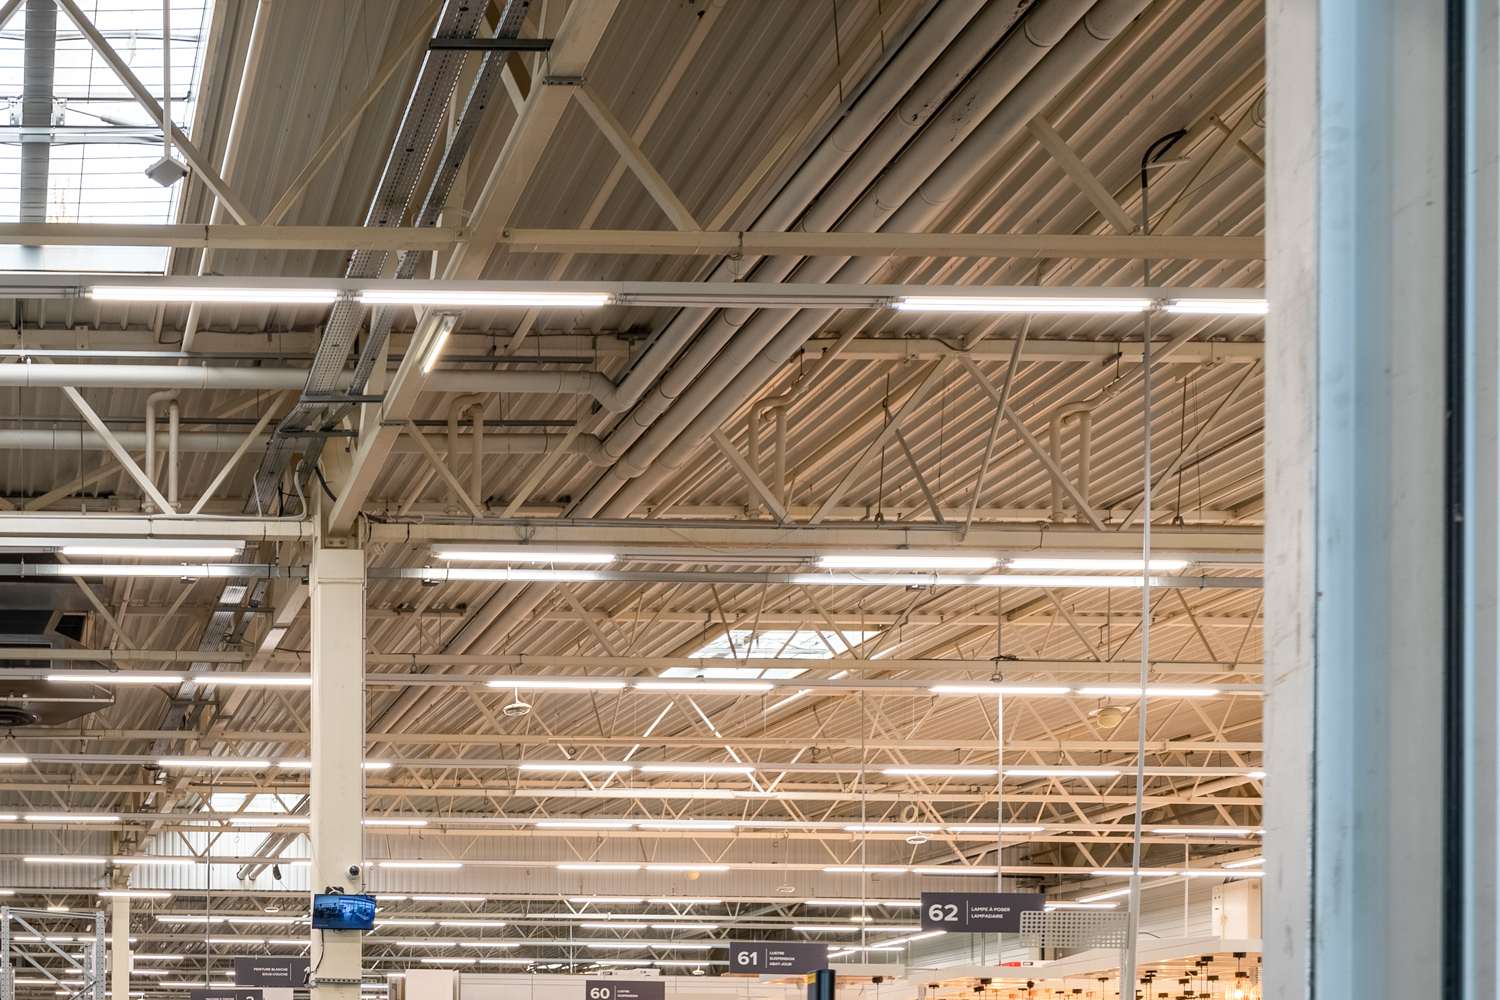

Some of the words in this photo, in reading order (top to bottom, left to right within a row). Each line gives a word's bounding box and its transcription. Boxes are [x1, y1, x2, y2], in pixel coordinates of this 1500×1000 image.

[928, 904, 958, 921] 62
[737, 951, 757, 965] 61
[590, 987, 610, 999] 60
